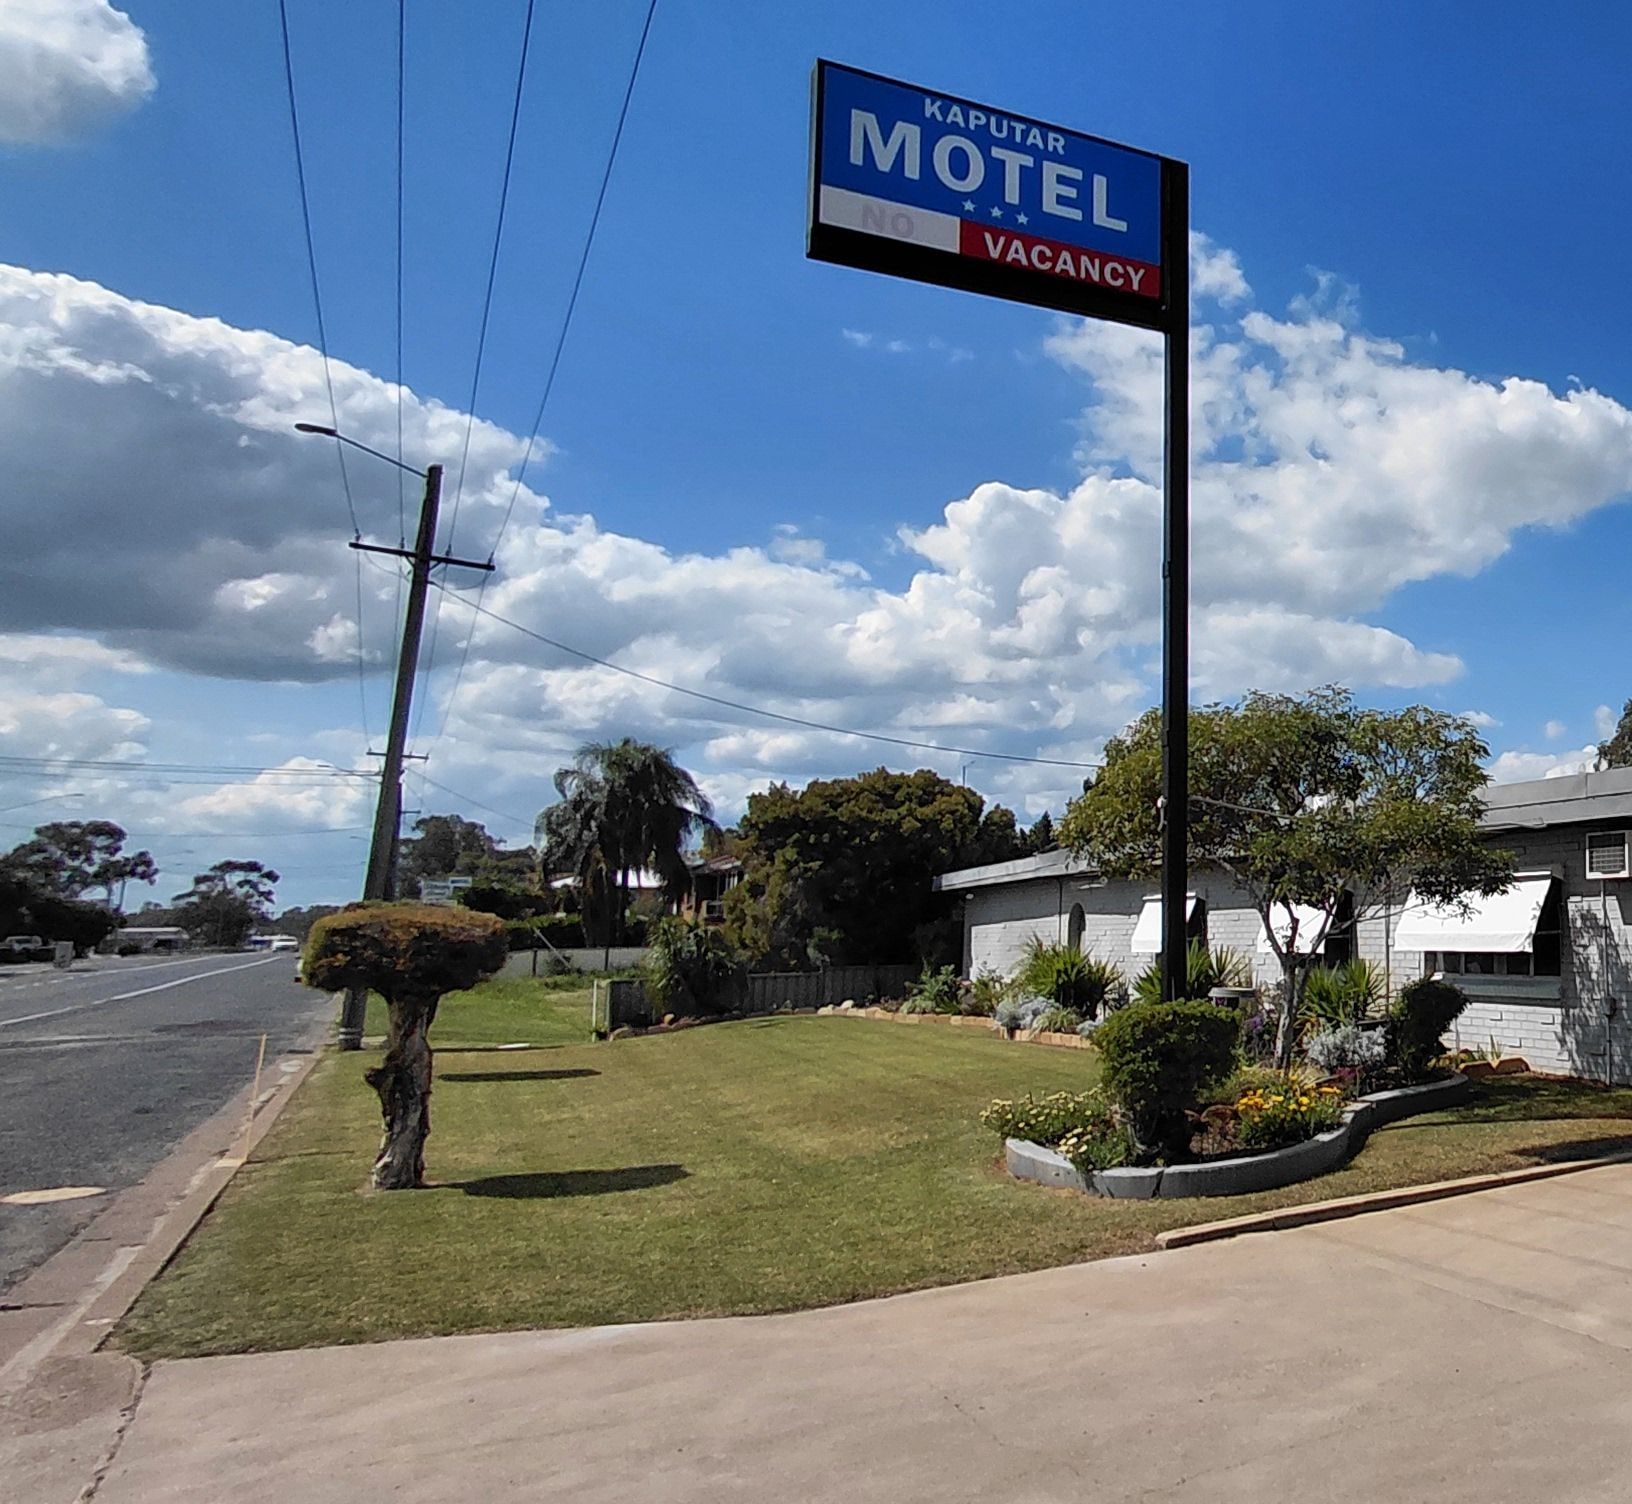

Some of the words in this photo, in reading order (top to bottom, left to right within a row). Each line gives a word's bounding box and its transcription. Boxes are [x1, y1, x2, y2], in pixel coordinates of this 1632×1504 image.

[849, 107, 1128, 233] MOTEL
[924, 97, 1066, 156] KAPUTAR
[861, 202, 915, 239] NO
[983, 231, 1146, 292] VACANCY
